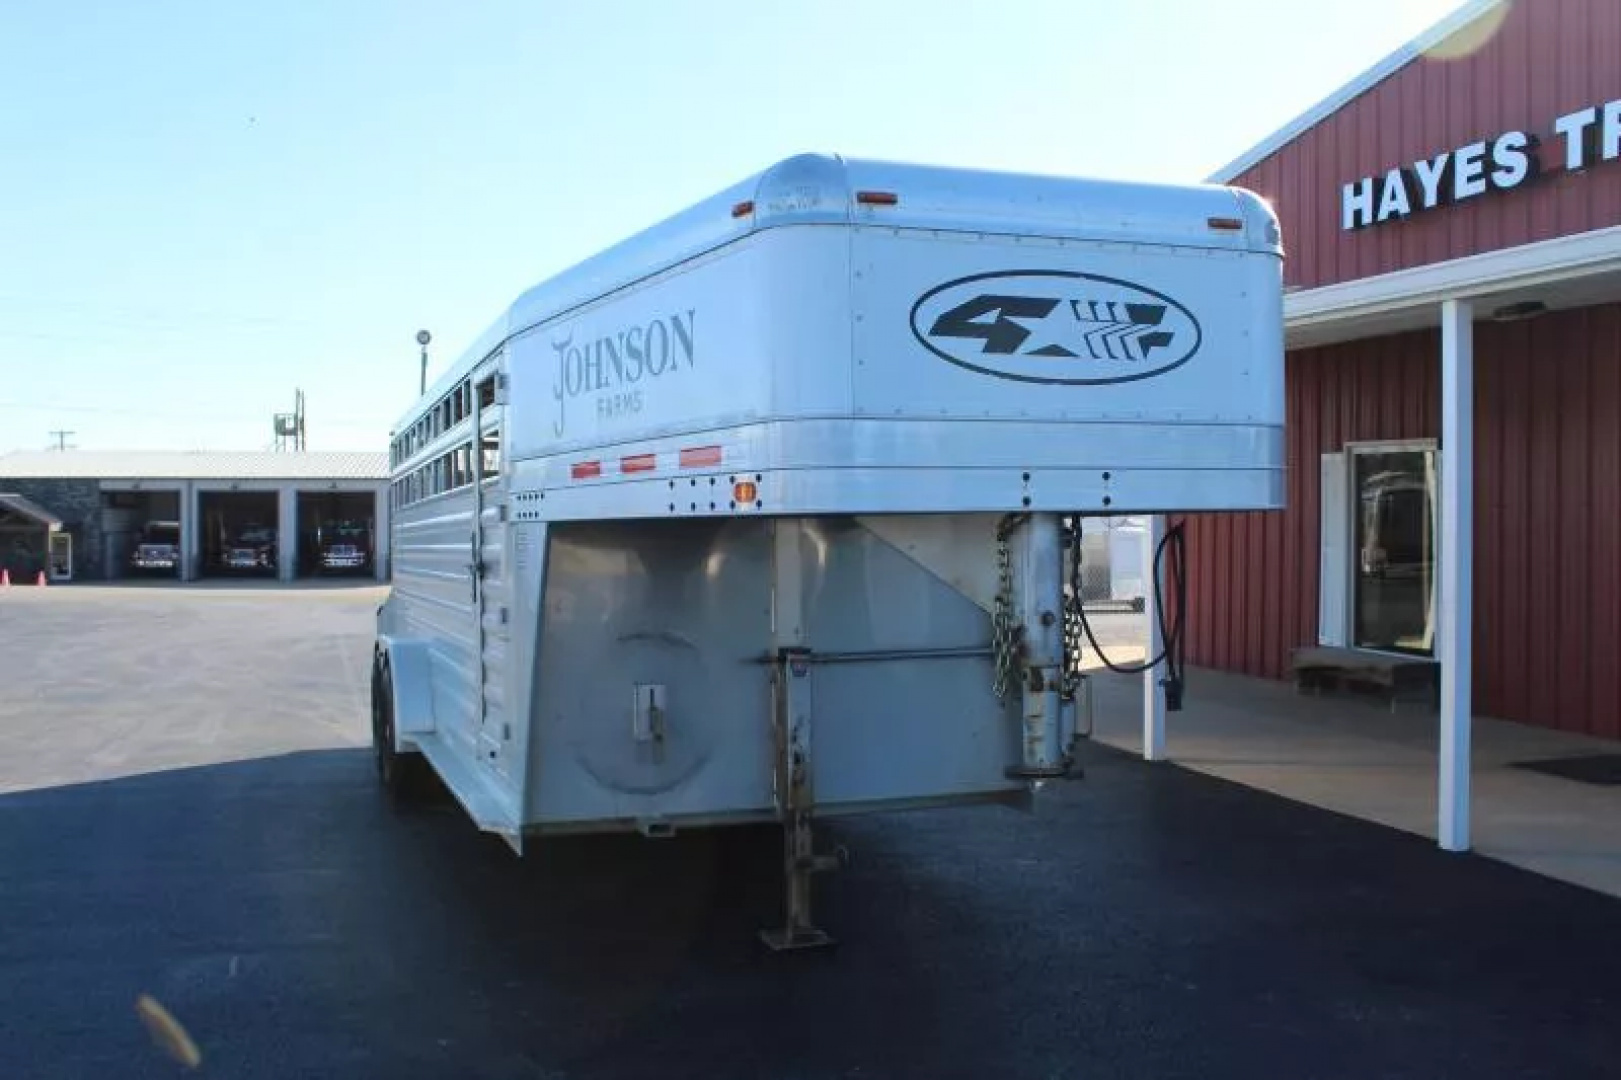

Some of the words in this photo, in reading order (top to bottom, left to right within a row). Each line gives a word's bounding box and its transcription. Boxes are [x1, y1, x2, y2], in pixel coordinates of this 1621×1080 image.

[1342, 130, 1529, 230] HAYES
[551, 308, 696, 437] JOHNSON
[597, 390, 643, 418] FARMS
